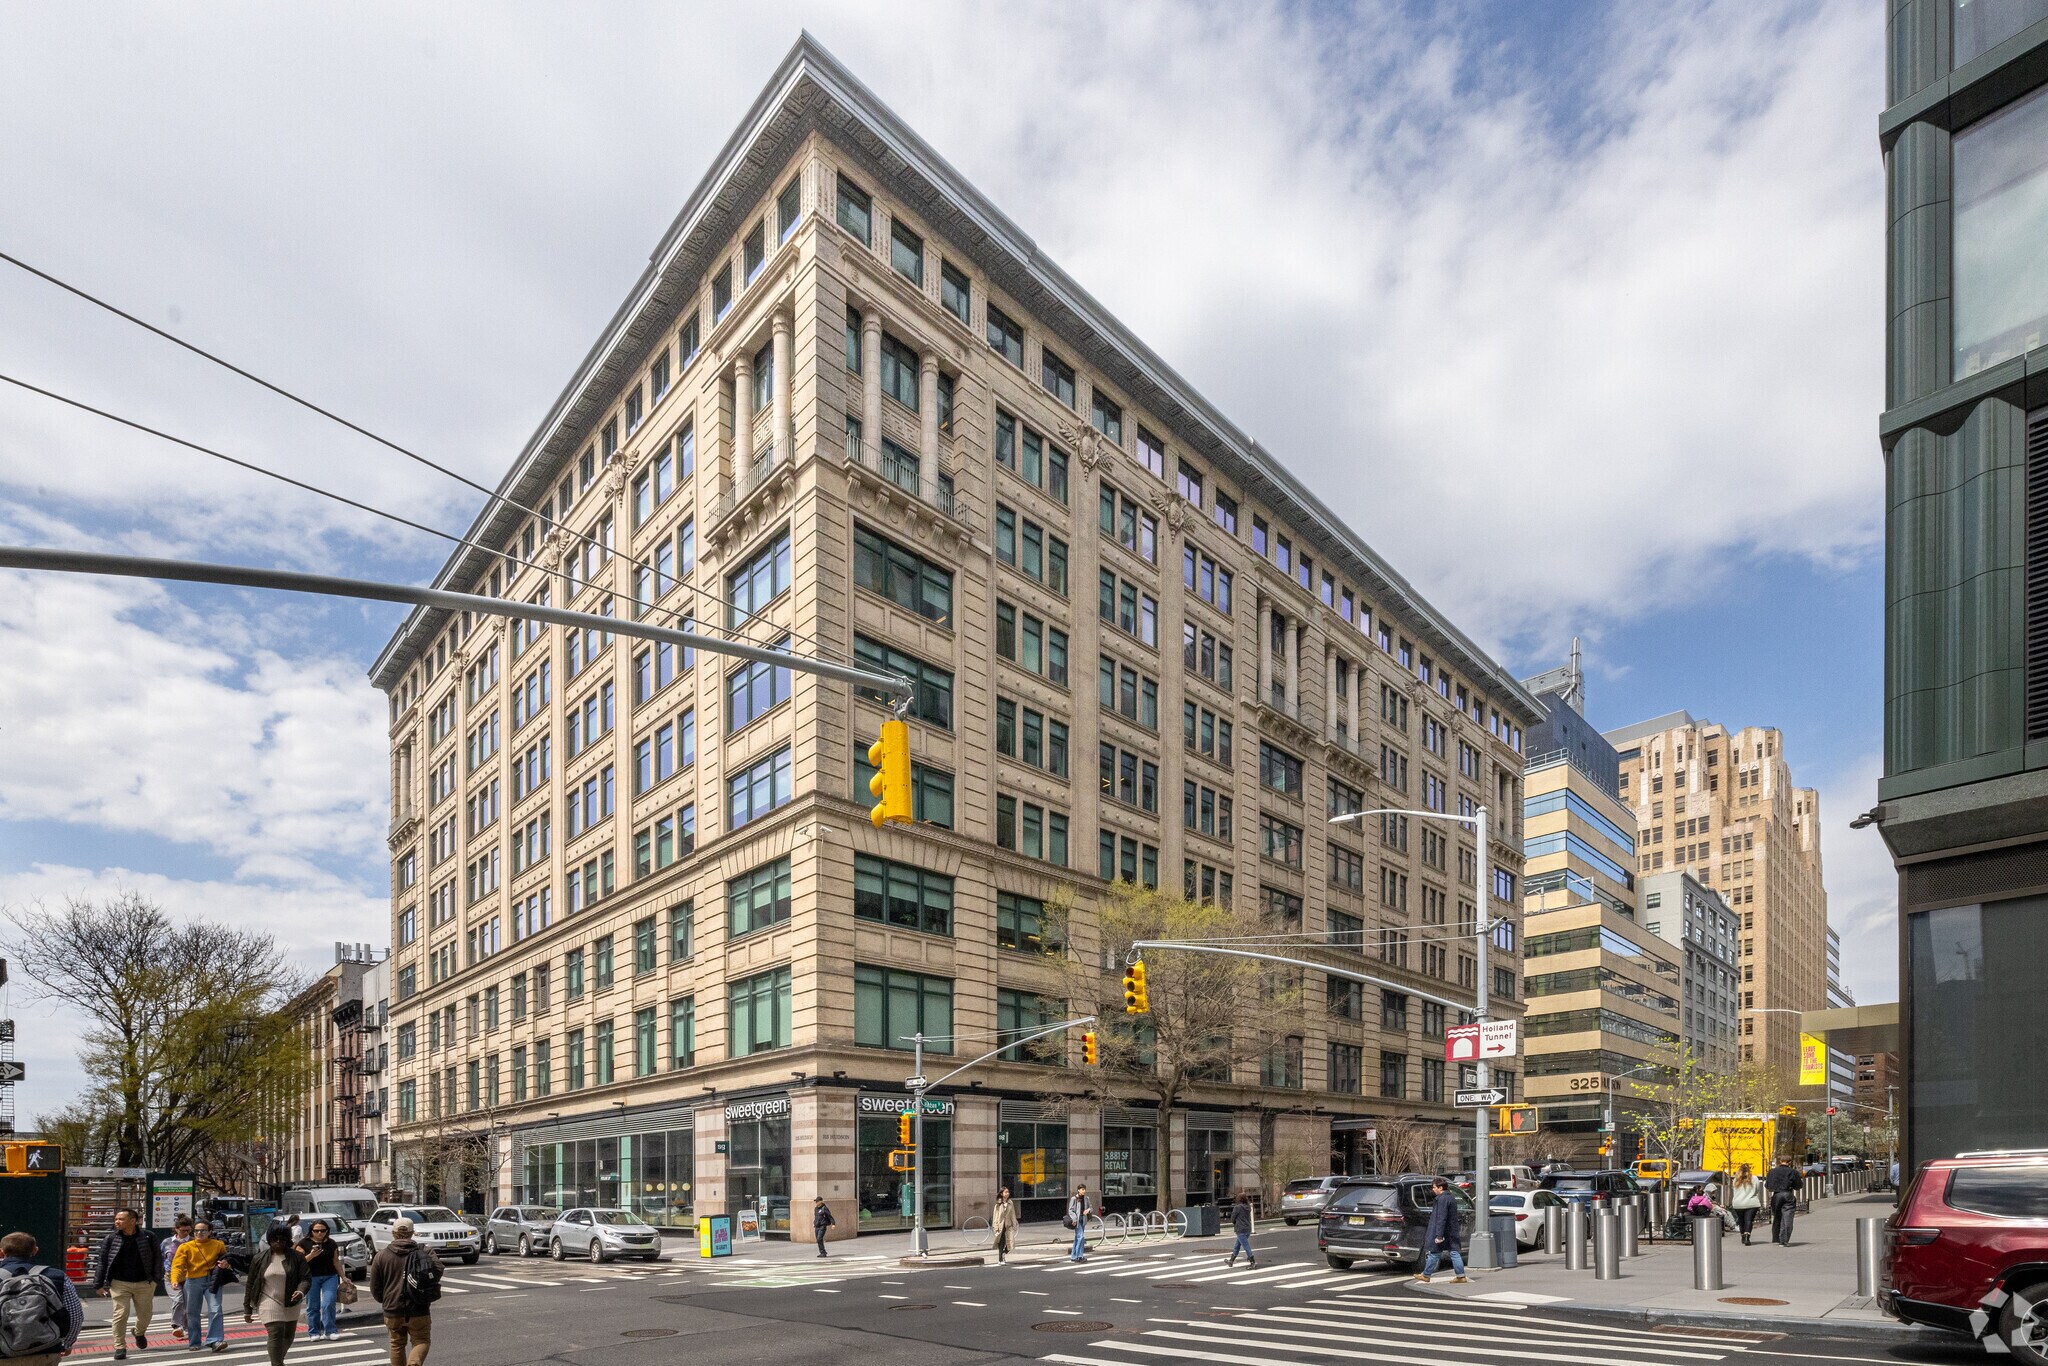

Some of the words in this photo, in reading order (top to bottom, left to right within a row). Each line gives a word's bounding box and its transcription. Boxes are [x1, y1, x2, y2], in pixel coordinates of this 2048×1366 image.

[1482, 1023, 1514, 1033] Holland
[1485, 1032, 1512, 1041] Tunnel
[1570, 1077, 1599, 1090] 325
[1481, 1093, 1497, 1101] WAY
[725, 1099, 787, 1119] sweetgreen
[862, 1097, 954, 1115] sweeten
[1121, 1151, 1129, 1160] SF
[1105, 1161, 1127, 1170] RETAIL
